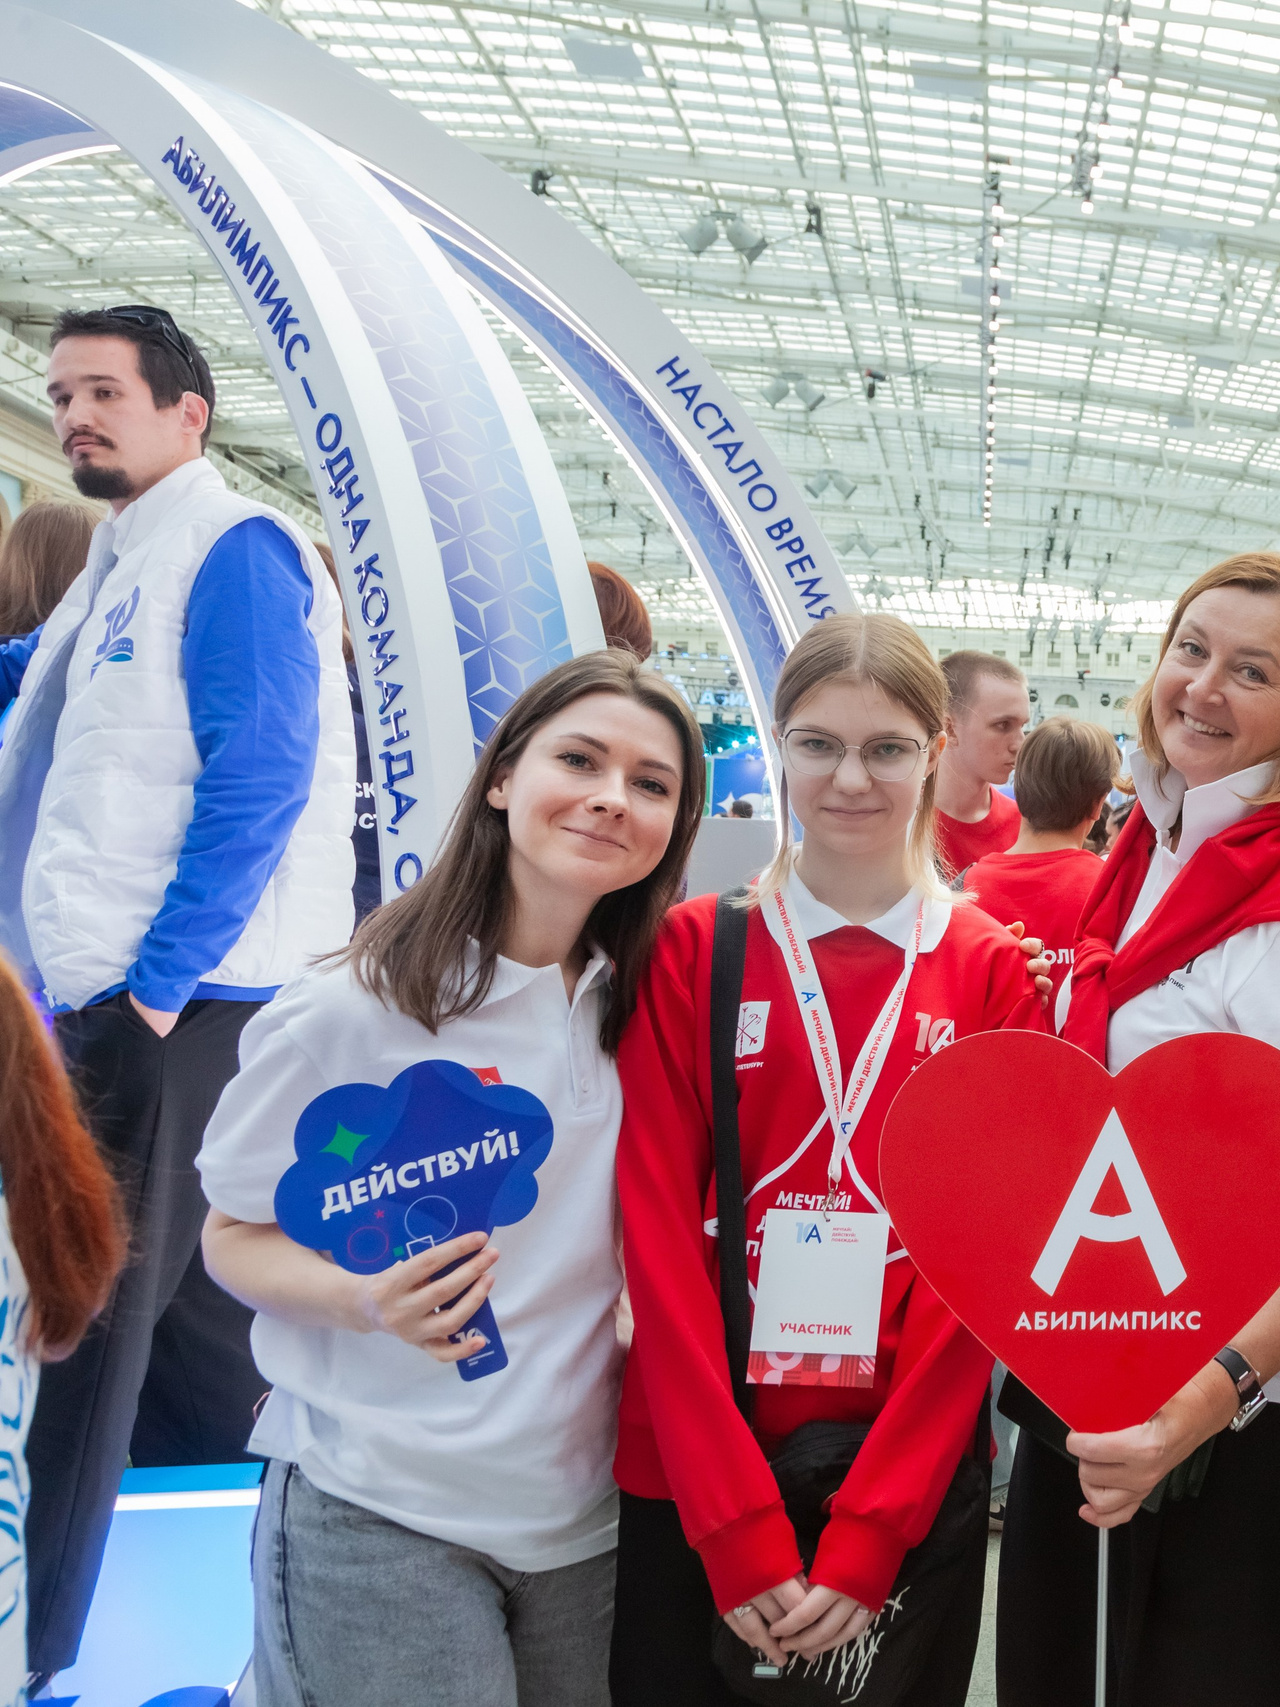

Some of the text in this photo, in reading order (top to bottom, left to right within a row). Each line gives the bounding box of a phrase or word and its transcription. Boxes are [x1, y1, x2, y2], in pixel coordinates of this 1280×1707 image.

[655, 355, 777, 512] НАСТАЛО
[161, 135, 310, 372] АБИЛИМПИКС
[316, 412, 371, 554] ОДНА
[353, 552, 418, 835] КОМАНДА,
[785, 926, 806, 974] ПОБЕЖДАЙ!
[810, 1009, 827, 1047] МЕЧТАЙ!
[819, 1045, 837, 1093] ДЕЙСТВУЙ!
[846, 1076, 866, 1114] МЕЧТАЙ!
[862, 1033, 885, 1078] ДЕЙСТВУЙ!
[321, 1128, 521, 1221] ДЕЙСТВУЙ!
[779, 1322, 853, 1336] УЧАСТНИК
[1014, 1311, 1202, 1331] АБИЛИМПИКС
